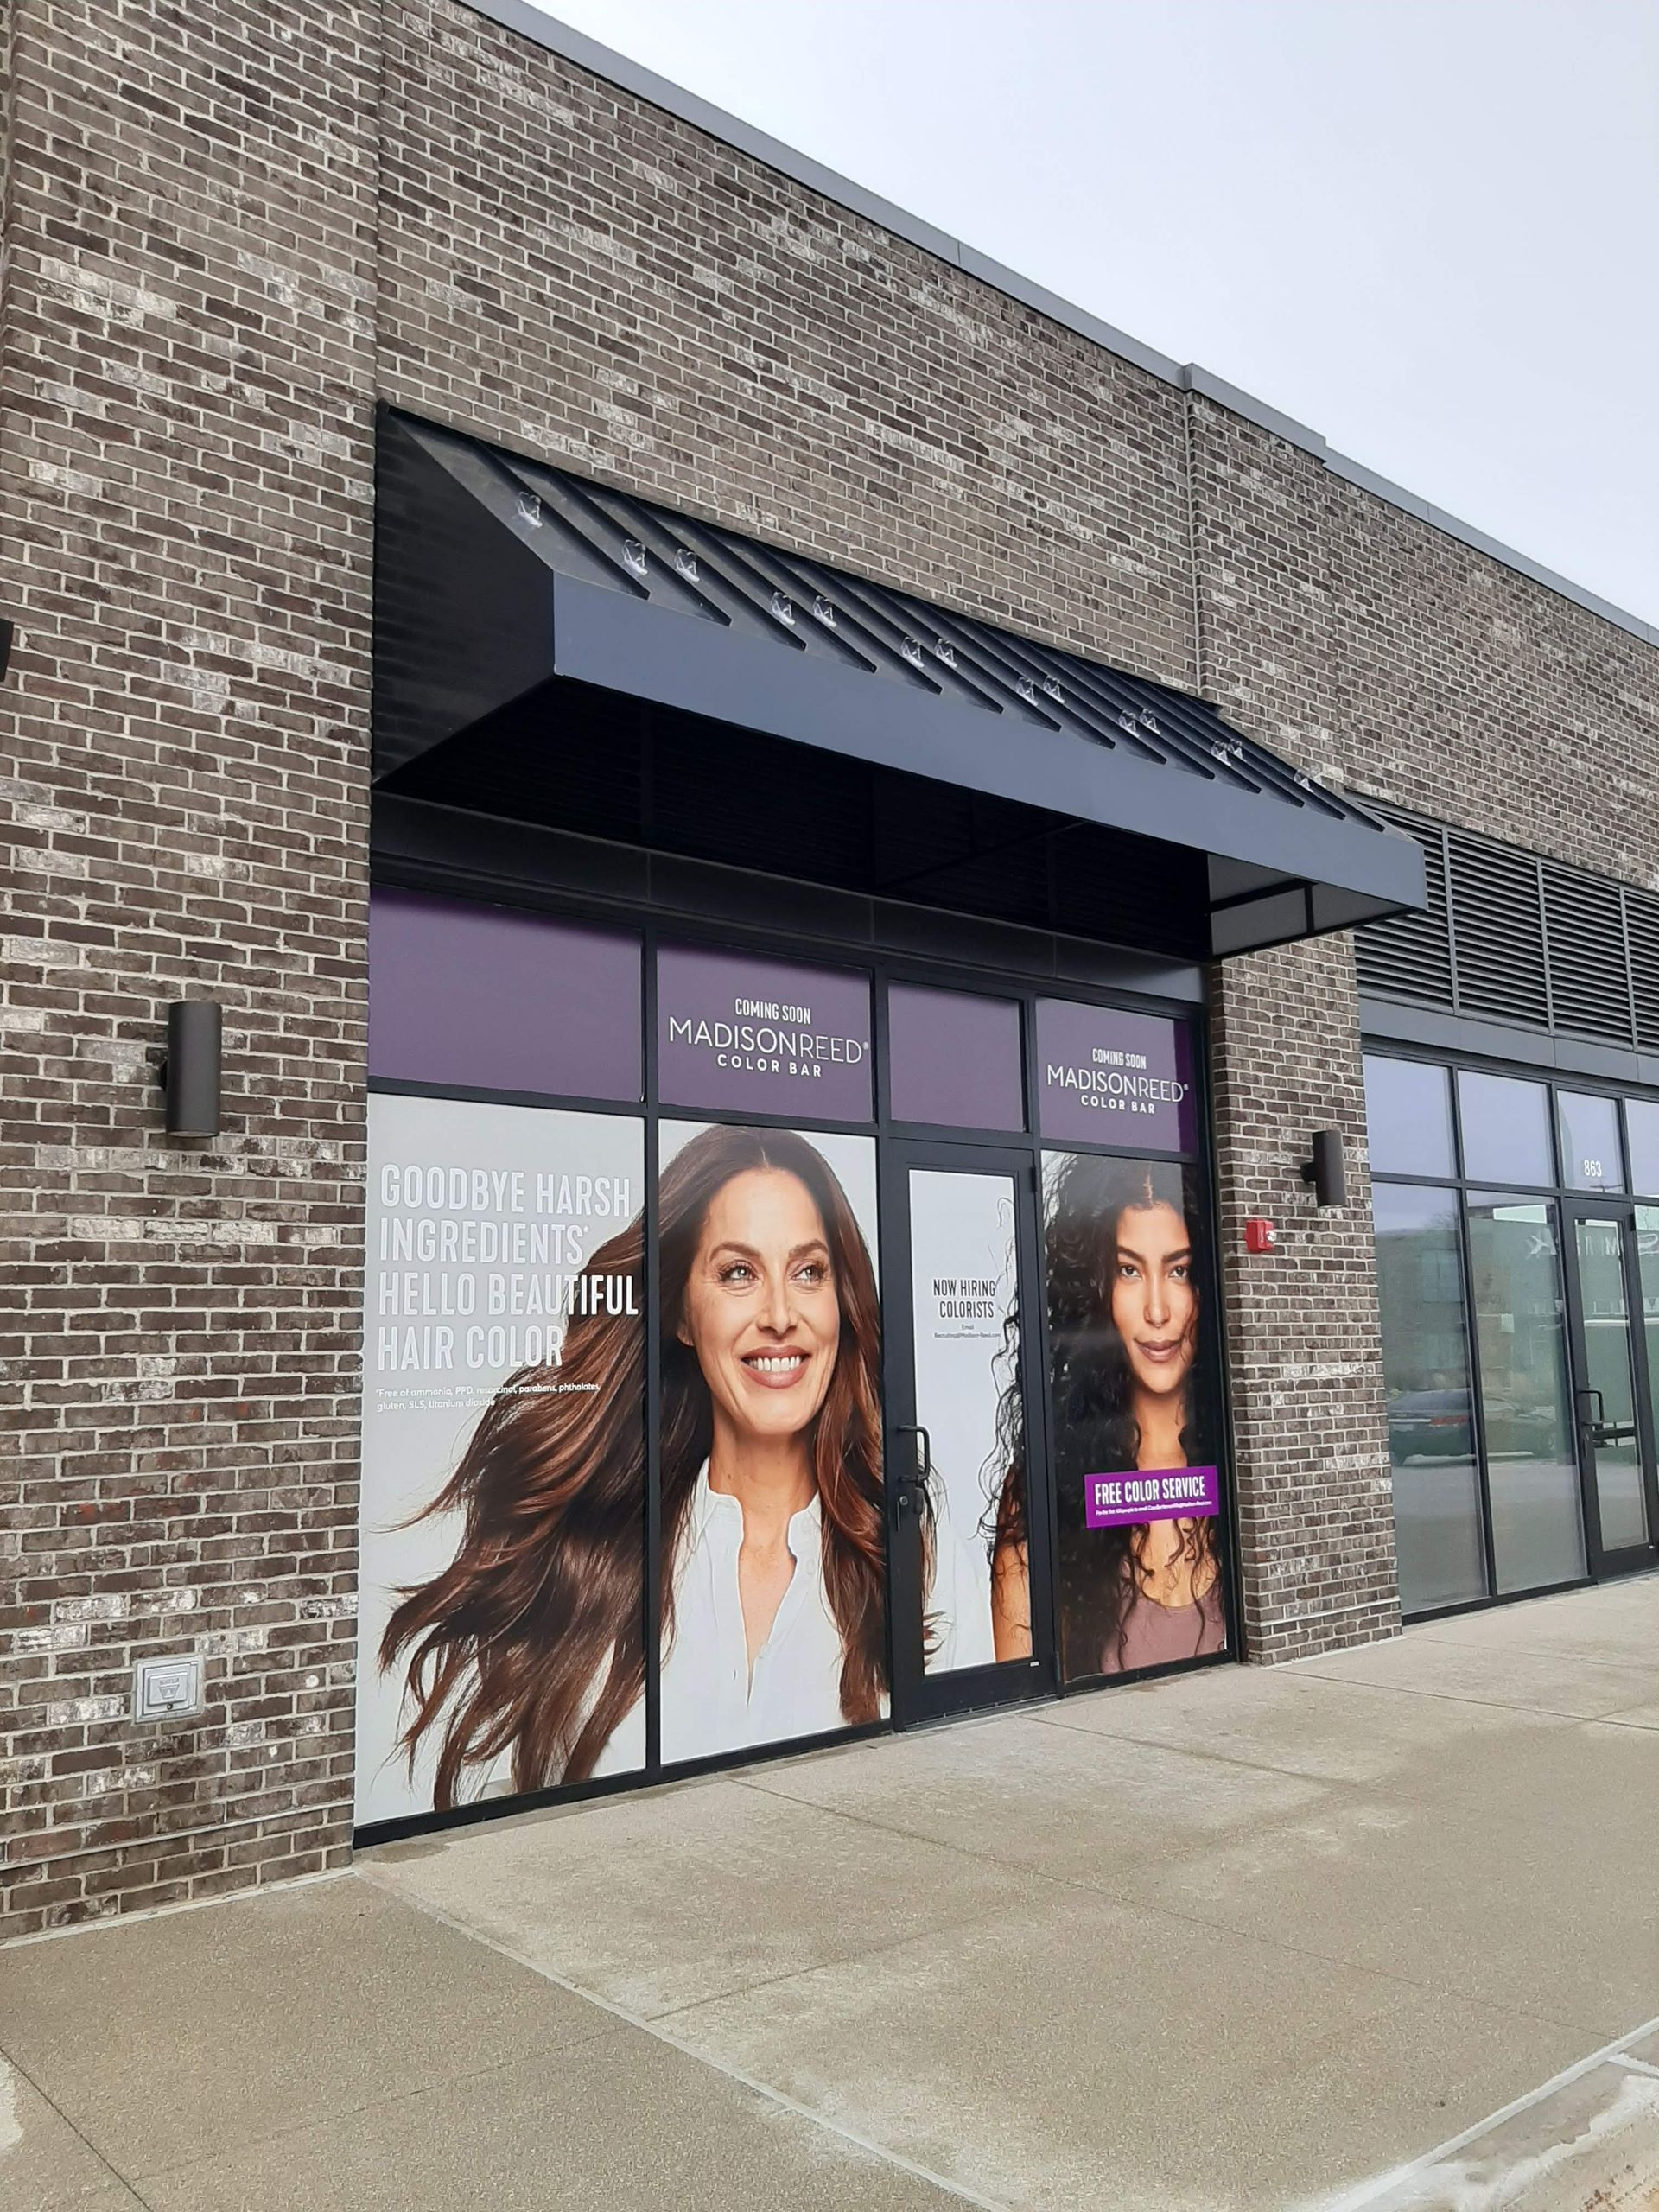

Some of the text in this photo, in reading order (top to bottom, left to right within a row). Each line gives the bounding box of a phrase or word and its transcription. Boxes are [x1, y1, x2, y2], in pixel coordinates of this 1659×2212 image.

[735, 998, 811, 1025] COMING SOON
[717, 1054, 822, 1077] COLOR BAR
[1092, 1048, 1147, 1070] COMING SOON
[1081, 1095, 1155, 1115] COLOR BAR
[1584, 1159, 1602, 1177] 863
[380, 1164, 630, 1217] GOODBYE HARSH
[378, 1271, 639, 1316] HELLO BEAUTIFUL
[933, 1278, 995, 1297] NOW HIRING
[939, 1300, 995, 1319] COLORISTS
[378, 1325, 563, 1370] HAIR COLOR
[400, 1387, 410, 1397] of
[1094, 1475, 1205, 1505] FREE COLOR SERVICE
